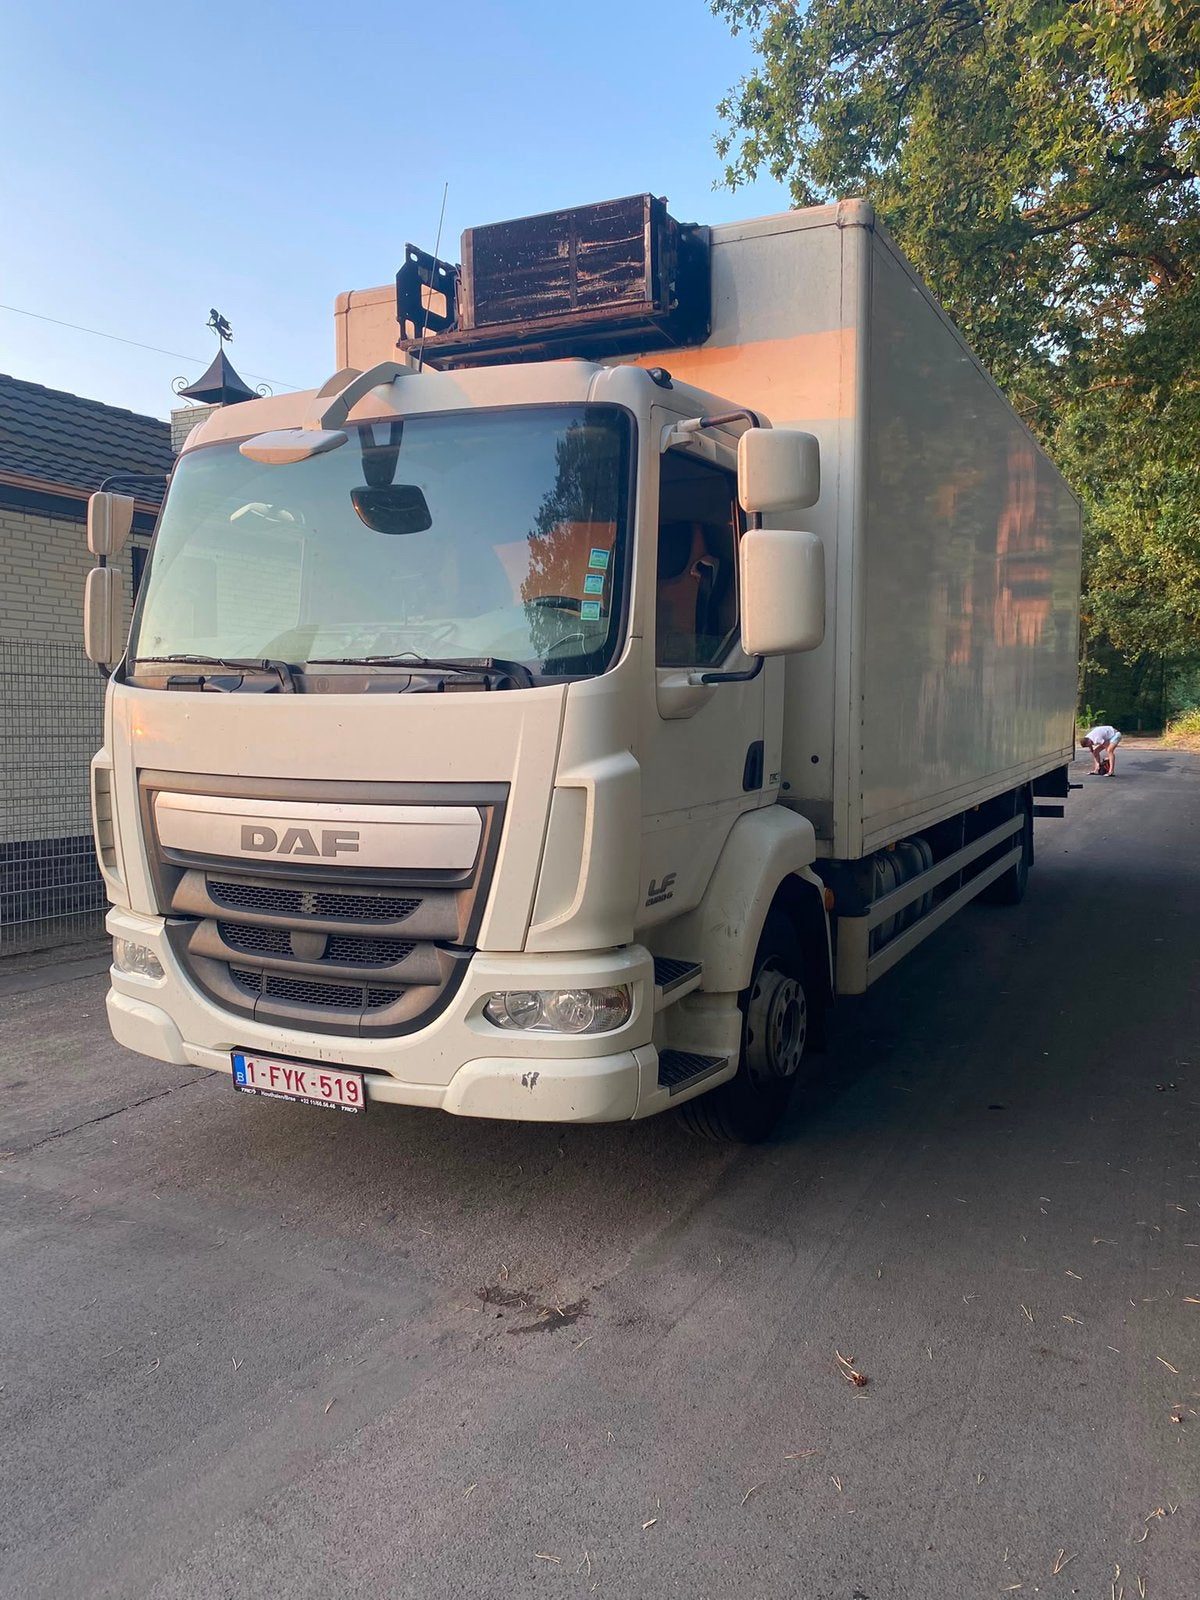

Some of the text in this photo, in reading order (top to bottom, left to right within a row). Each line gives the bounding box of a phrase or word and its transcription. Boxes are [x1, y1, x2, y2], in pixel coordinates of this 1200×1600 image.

[241, 825, 359, 857] DAF
[648, 872, 677, 896] LF
[237, 1071, 245, 1082] B
[247, 1062, 358, 1103] 1-FYK-519
